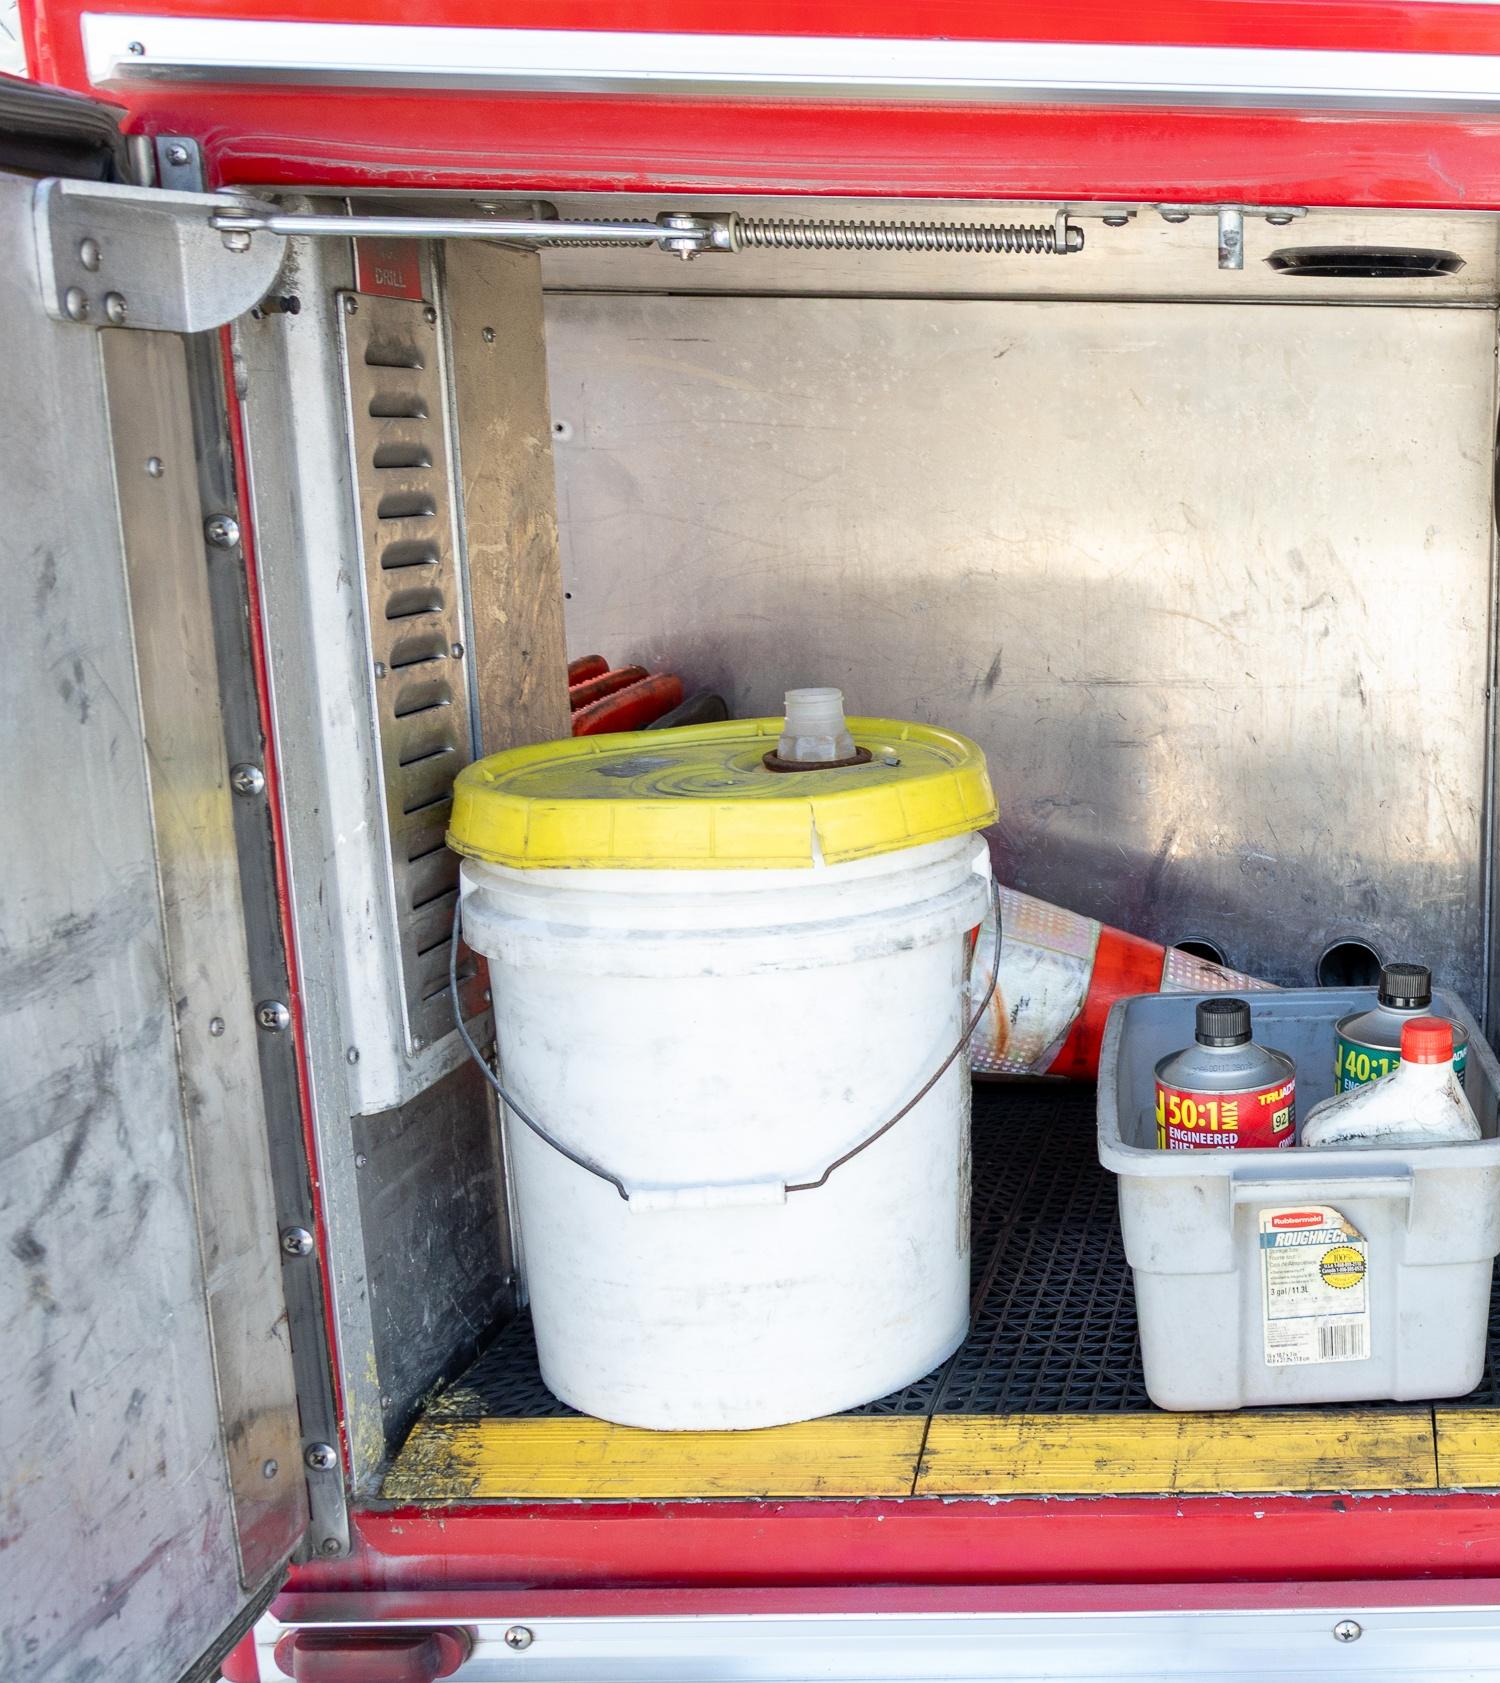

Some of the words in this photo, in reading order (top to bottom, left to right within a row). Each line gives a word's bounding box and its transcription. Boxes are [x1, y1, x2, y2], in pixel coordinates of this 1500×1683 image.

[1169, 1095, 1218, 1131] 50:1
[1221, 1101, 1239, 1130] MIX
[1276, 1113, 1287, 1128] 92
[1169, 1126, 1239, 1145] ENGINEERED
[1275, 1230, 1348, 1246] ROUGHNECK
